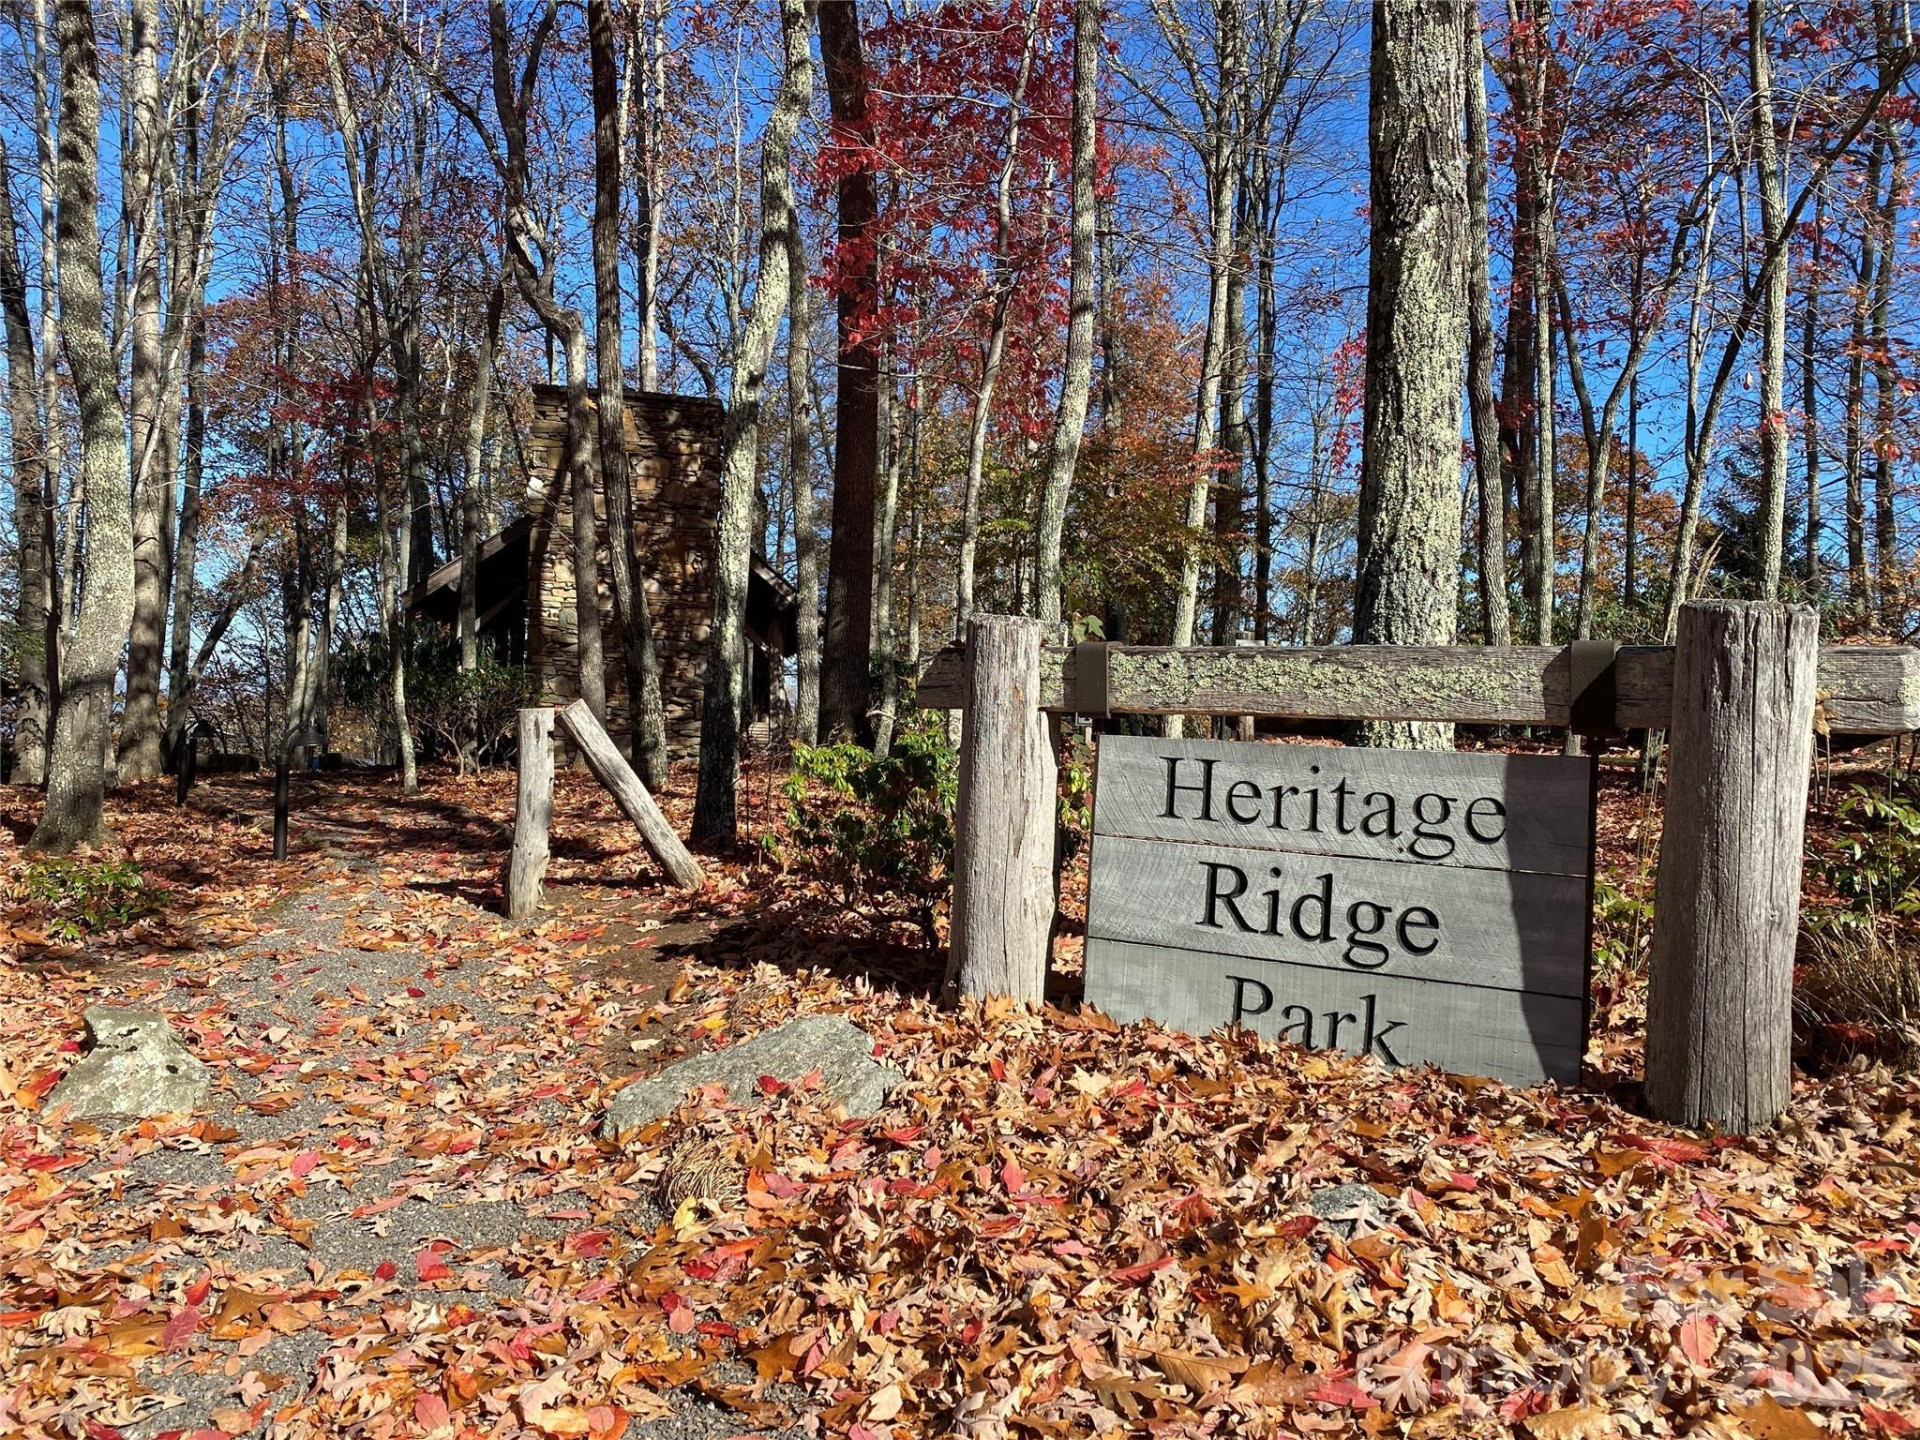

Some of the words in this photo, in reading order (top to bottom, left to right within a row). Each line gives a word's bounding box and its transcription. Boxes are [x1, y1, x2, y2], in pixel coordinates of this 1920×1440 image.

[1157, 756, 1508, 860] Heritage
[1195, 860, 1440, 970] Ridge
[1225, 974, 1408, 1068] Park
